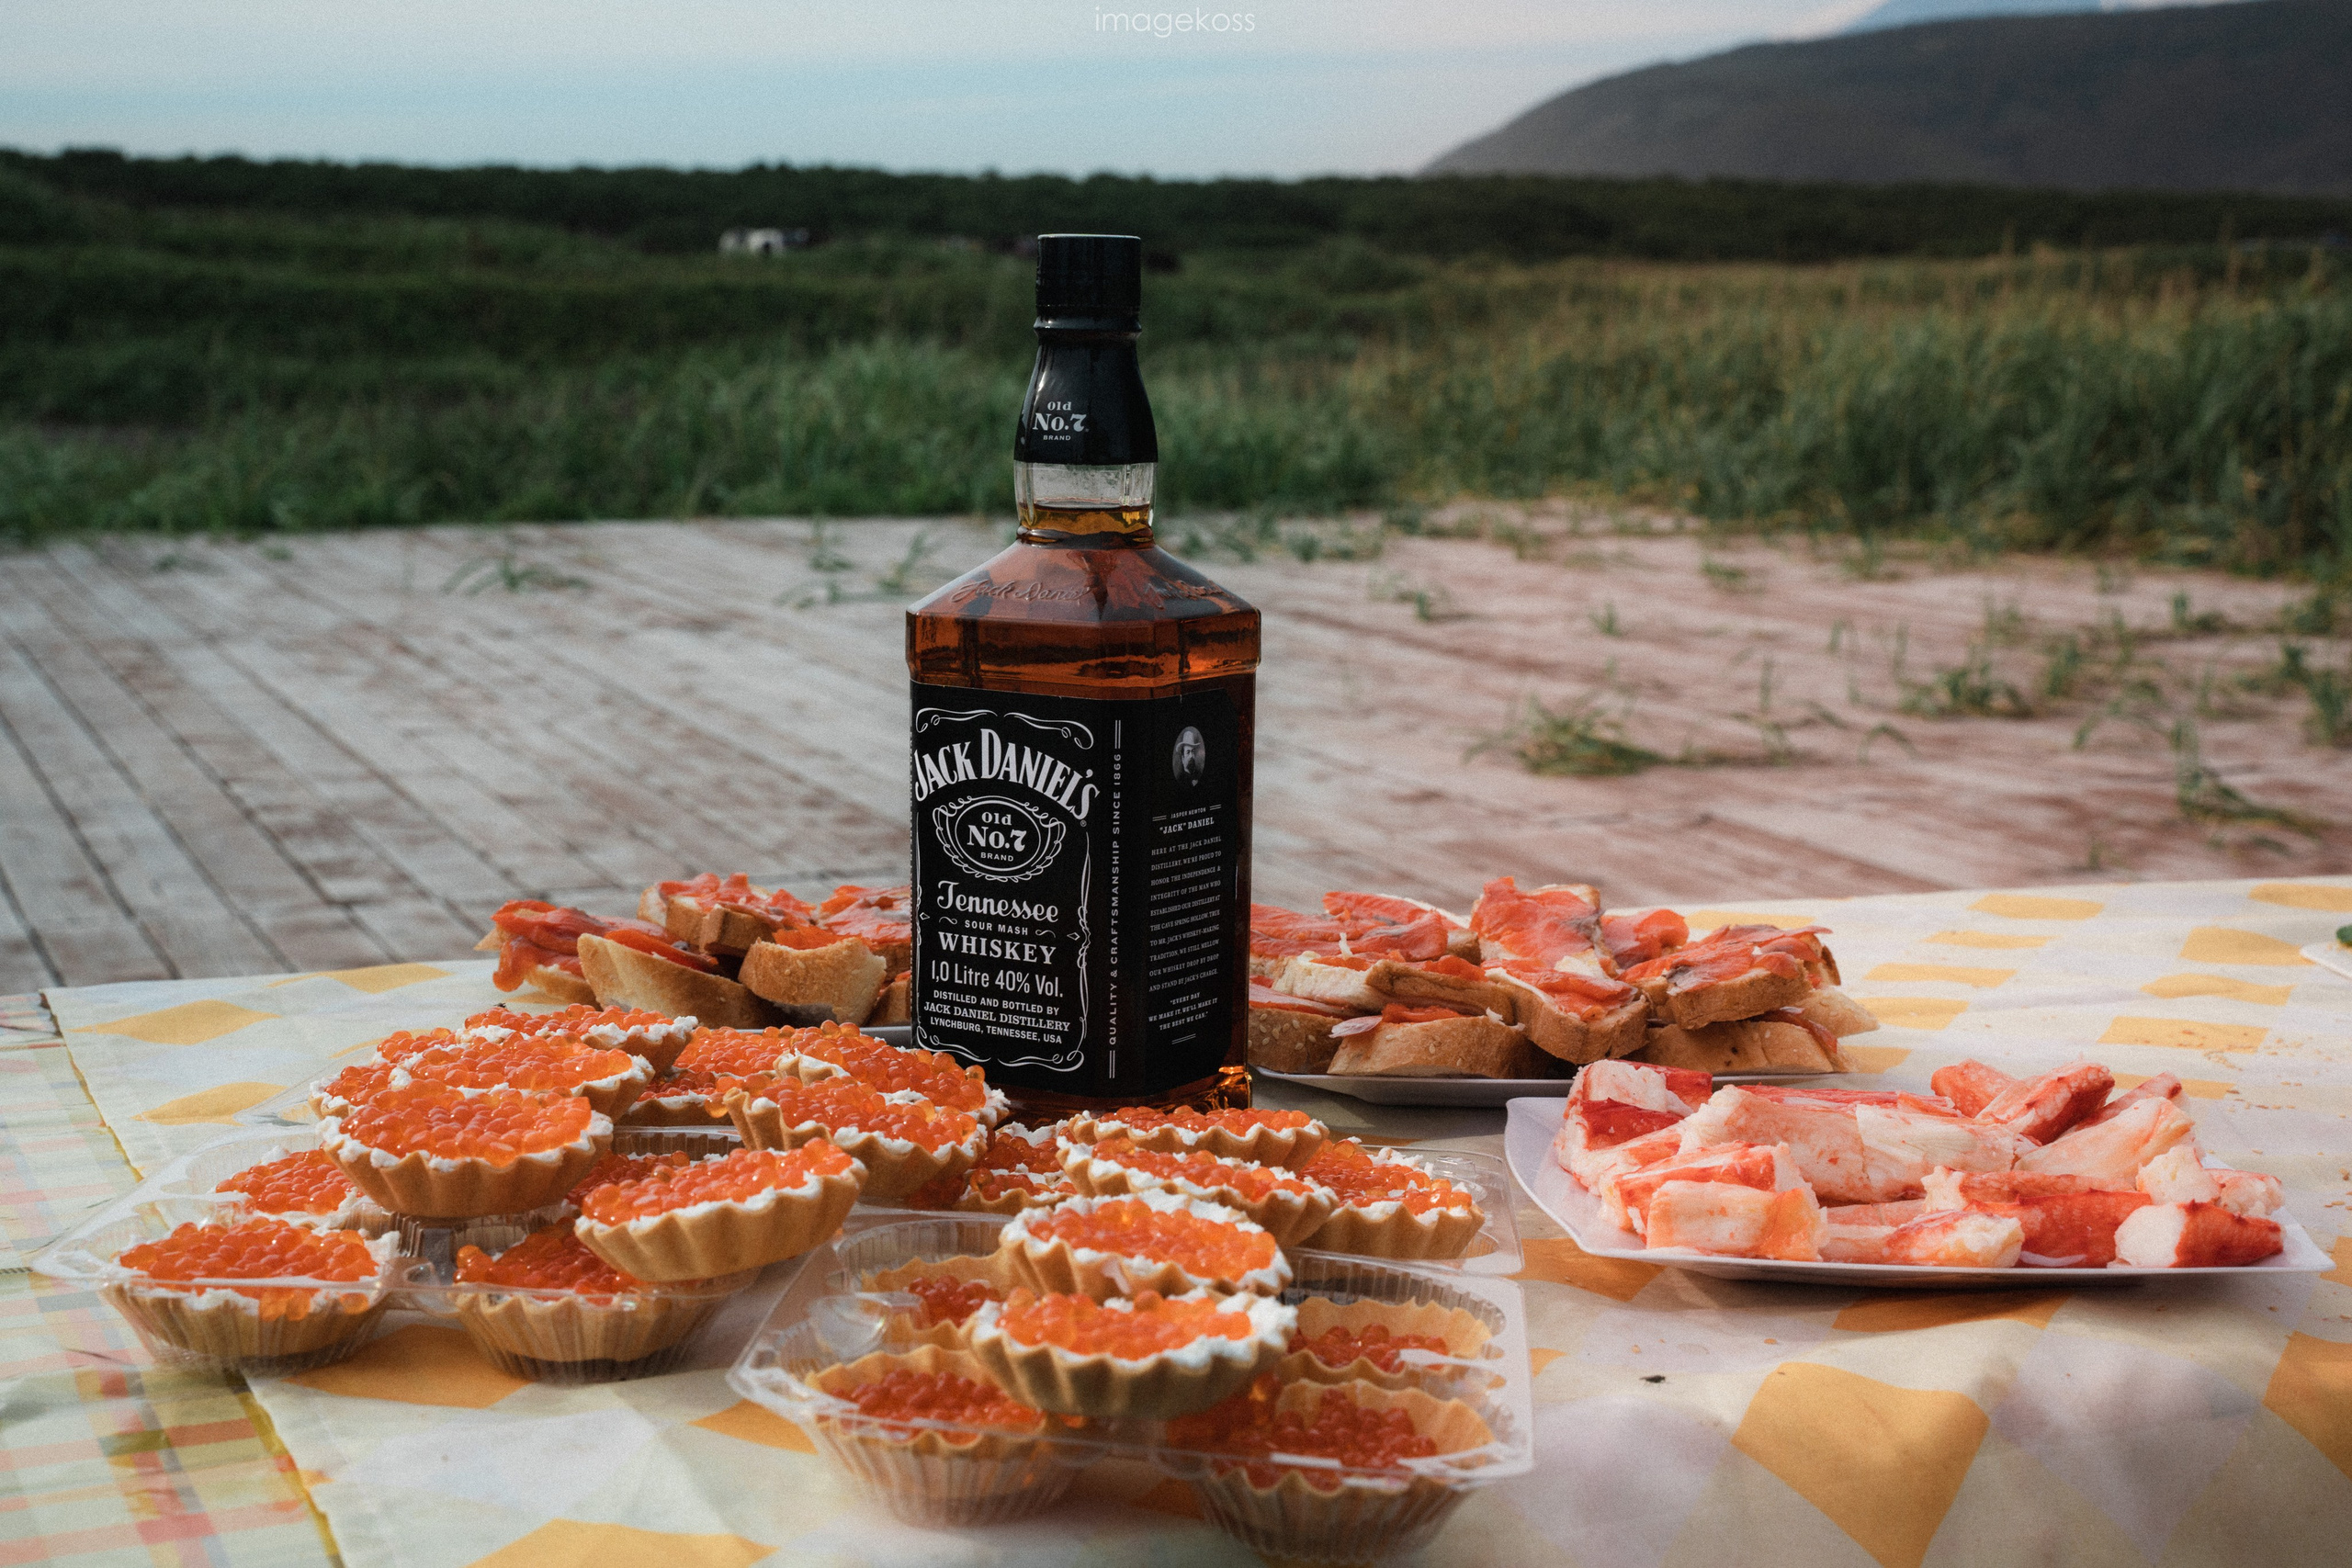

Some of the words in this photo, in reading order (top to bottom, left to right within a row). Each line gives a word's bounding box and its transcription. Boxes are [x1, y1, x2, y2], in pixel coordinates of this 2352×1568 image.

[1046, 401, 1072, 412] Old
[1032, 412, 1087, 433] No.7
[914, 741, 978, 802] JACK
[980, 728, 1101, 820] DANIEL'S
[1114, 753, 1122, 785] 1866
[981, 811, 1012, 826] Old
[1112, 792, 1121, 835] SINCE
[1170, 810, 1188, 819] JASPER
[1159, 822, 1187, 834] "JACK"
[1187, 817, 1215, 829] DANIEL
[967, 825, 1027, 852] No.7
[1151, 847, 1167, 856] HERE
[1189, 840, 1202, 850] JACK
[1203, 836, 1222, 845] DANIEL
[980, 852, 1014, 862] BRAND
[1198, 852, 1215, 862] PROUD
[1150, 876, 1170, 886] HONOR
[936, 880, 1059, 923] Tennessee
[1150, 889, 1181, 901] INTEGRITY
[1188, 885, 1198, 894] THE
[1110, 840, 1120, 964] CRAFTSMANSHIP
[965, 919, 993, 931] SOUR
[998, 924, 1029, 936] MASH
[1150, 923, 1160, 931] THE
[1160, 921, 1174, 930] CAVE
[938, 931, 1057, 964] WHISKEY
[932, 959, 950, 983] 1,0
[955, 963, 989, 987] Litre
[995, 969, 1030, 994] 40%
[1035, 974, 1064, 998] Vol.
[1110, 969, 1118, 978] &
[1148, 968, 1161, 976] OUR
[1148, 984, 1160, 992] AND
[933, 989, 977, 1004] DISTILLED
[980, 997, 999, 1008] AND
[1002, 999, 1043, 1014] BOTTLED
[1046, 1006, 1059, 1016] BY
[923, 1001, 951, 1015] JACK
[954, 1007, 996, 1021] DANIEL
[999, 1013, 1071, 1032] DISTILLERY
[1109, 983, 1117, 1045] QUALITY
[1158, 1010, 1174, 1020] MAKE
[930, 1017, 984, 1034] LYNCHBURG,
[986, 1025, 1041, 1043] TENNESSEE,
[1043, 1033, 1062, 1044] USA
[1159, 1022, 1170, 1031] THE
[1171, 1019, 1185, 1028] BEST
[1186, 1015, 1194, 1023] WE
